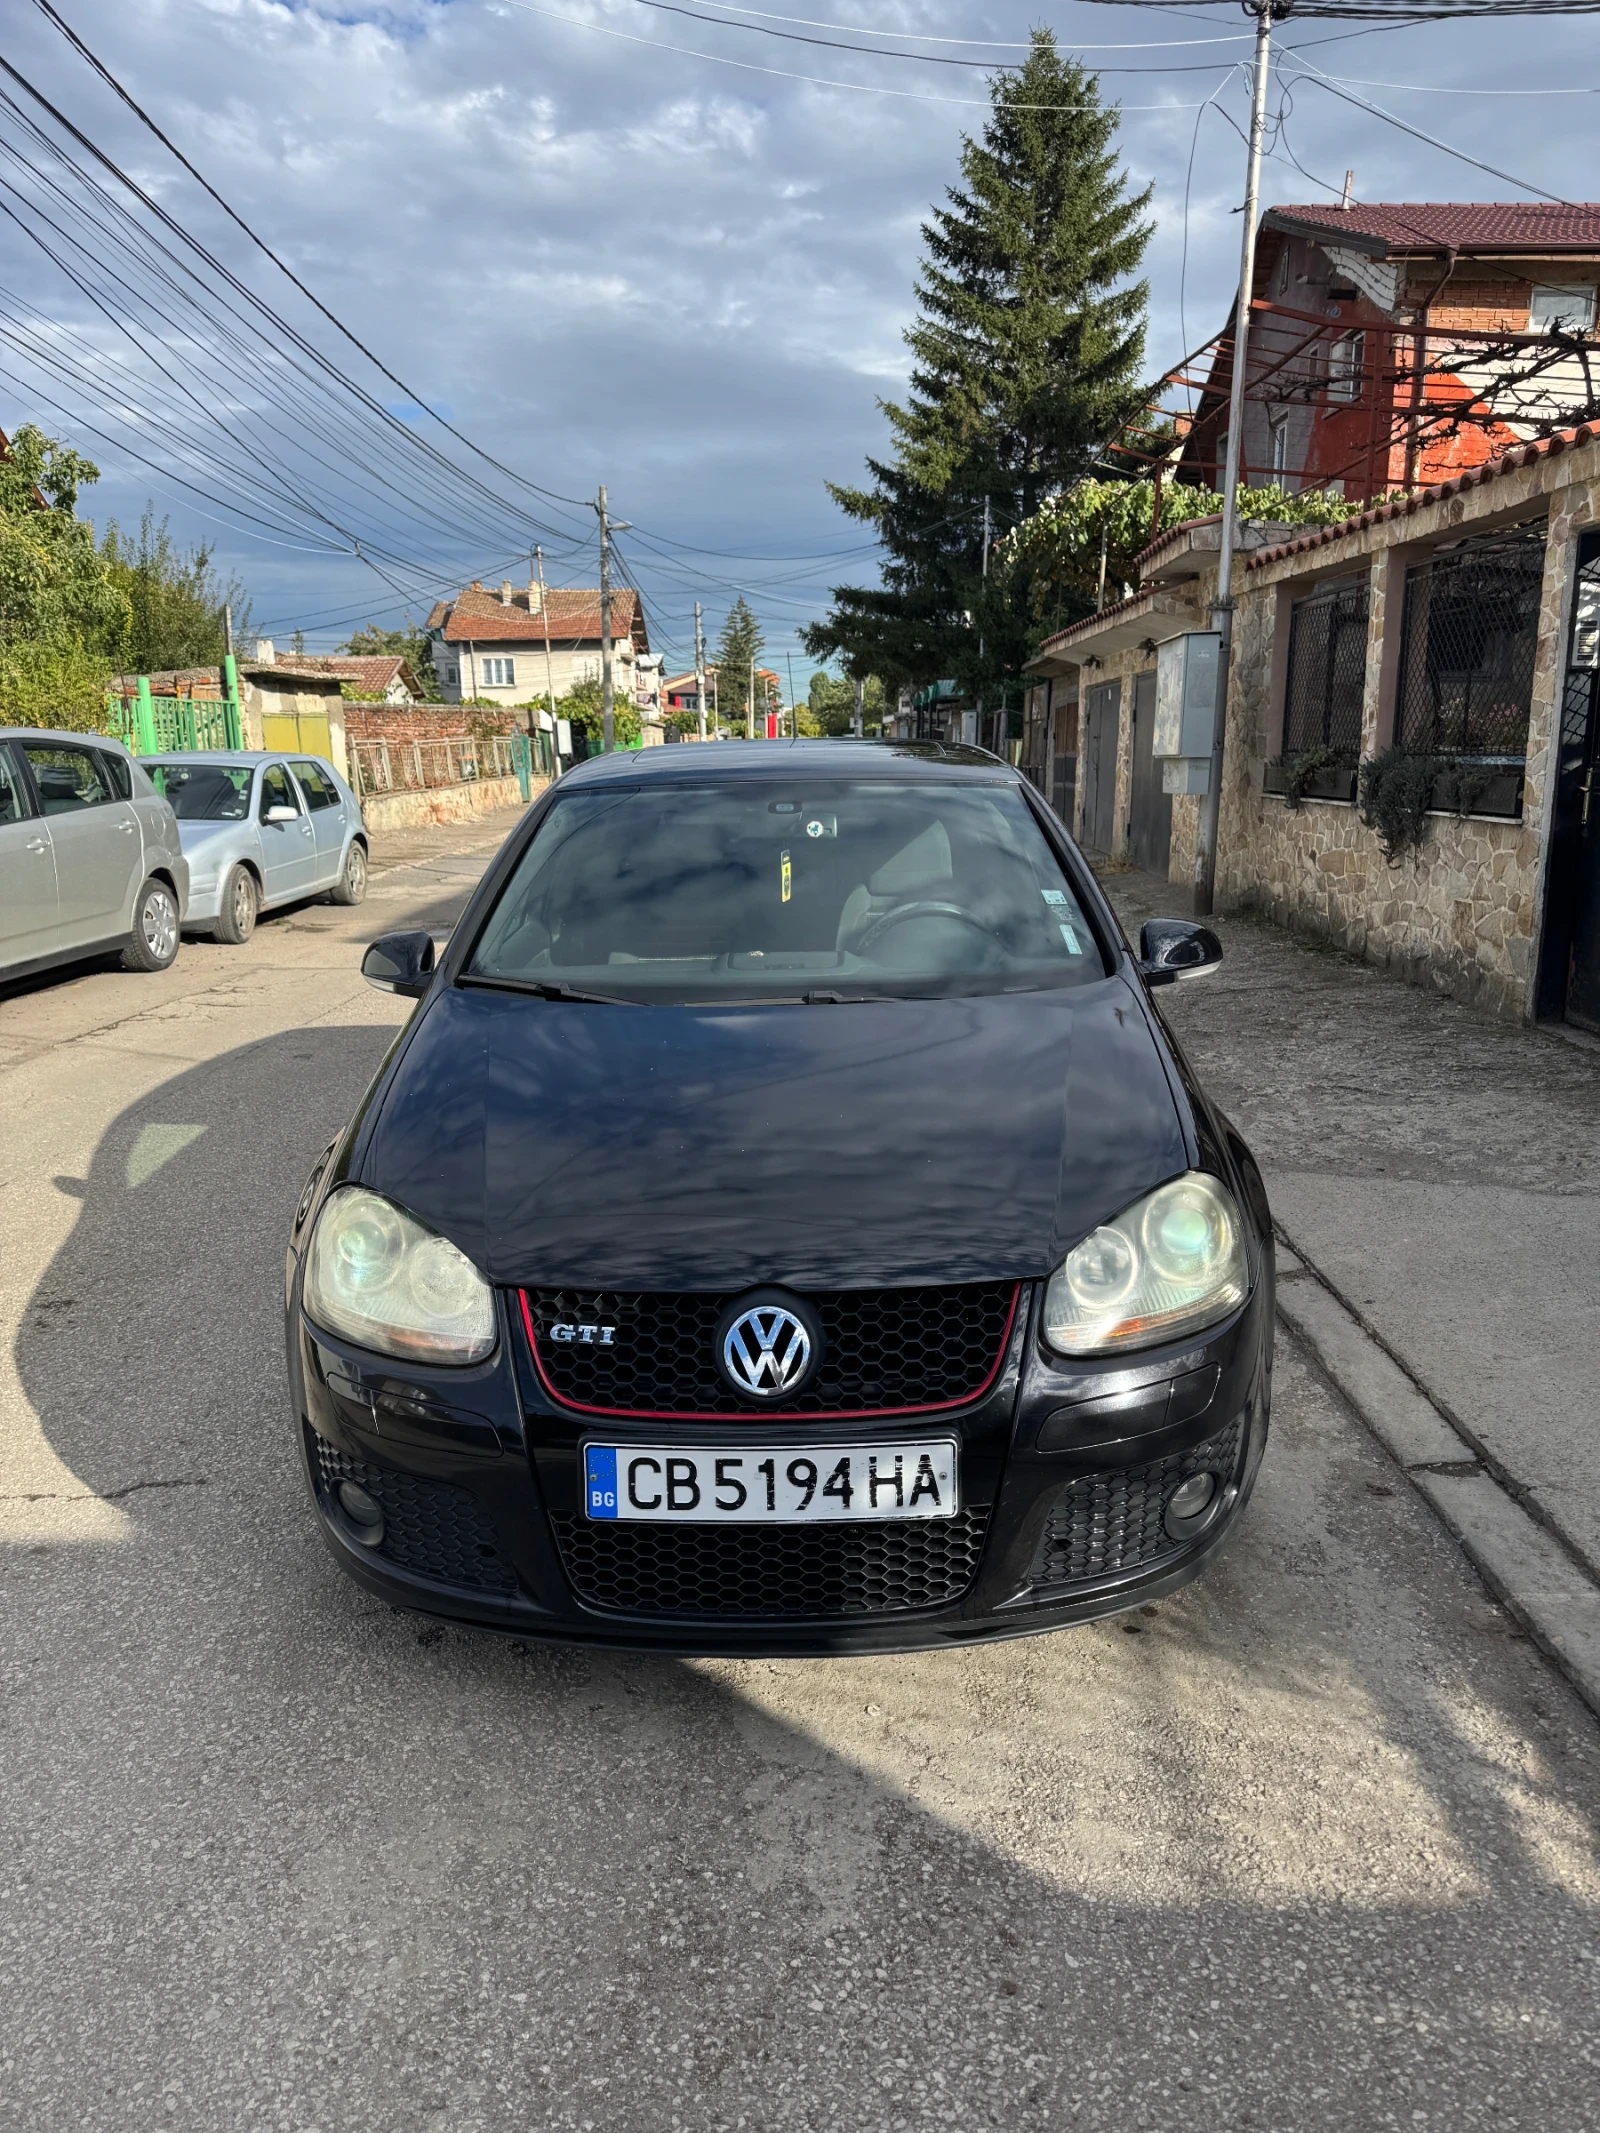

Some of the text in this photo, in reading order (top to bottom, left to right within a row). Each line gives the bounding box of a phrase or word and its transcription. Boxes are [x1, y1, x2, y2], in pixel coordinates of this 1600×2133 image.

[550, 1324, 616, 1345] GTI
[724, 1306, 810, 1395] VW
[592, 1491, 615, 1507] BG
